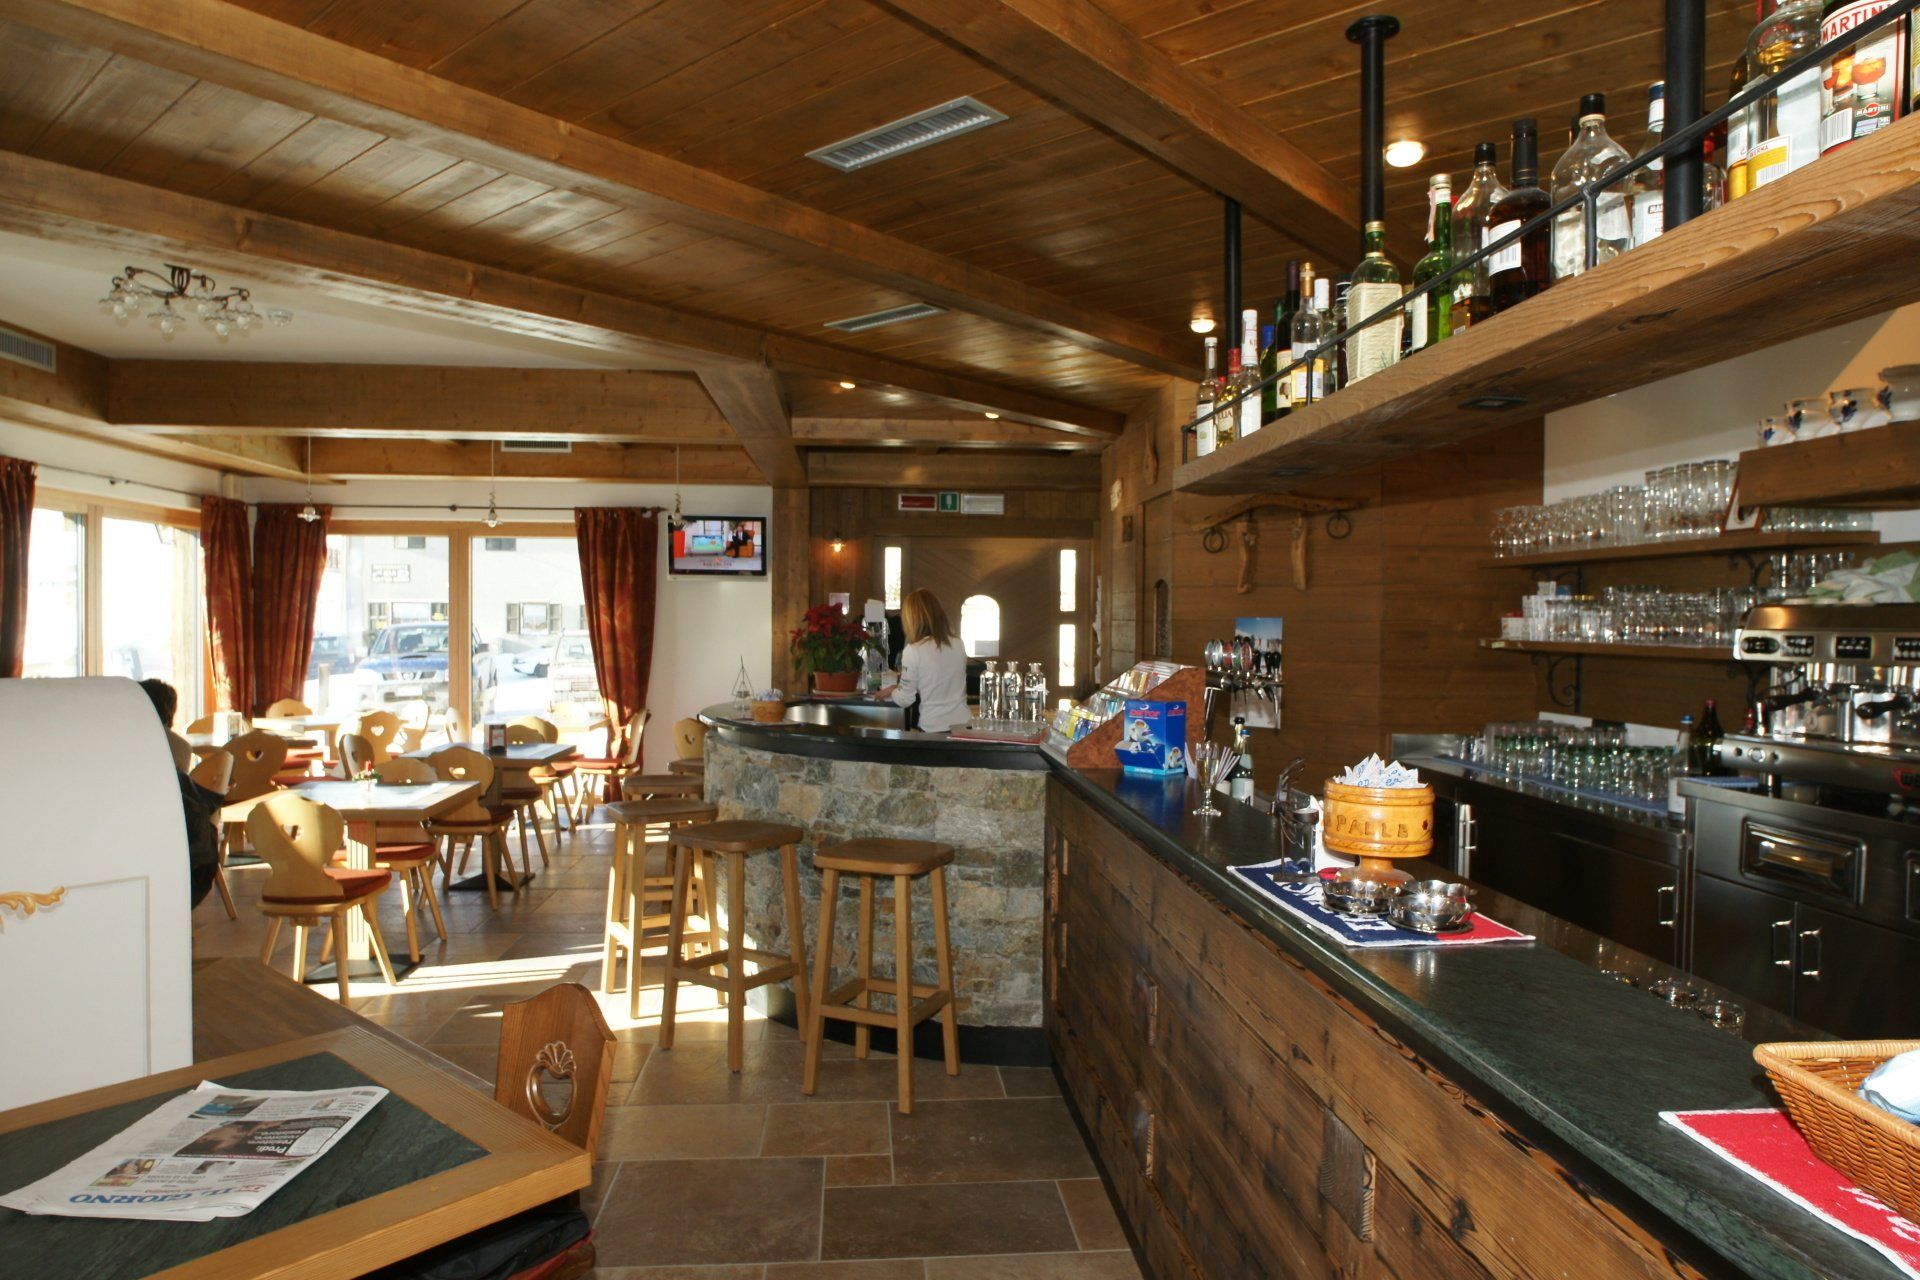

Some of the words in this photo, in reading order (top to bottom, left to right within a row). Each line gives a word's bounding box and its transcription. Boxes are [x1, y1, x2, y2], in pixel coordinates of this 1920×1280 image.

[1822, 3, 1892, 43] MARTIN
[1856, 104, 1890, 116] MARTINI
[201, 1187, 235, 1197] IL
[69, 1193, 193, 1204] GIORNO
